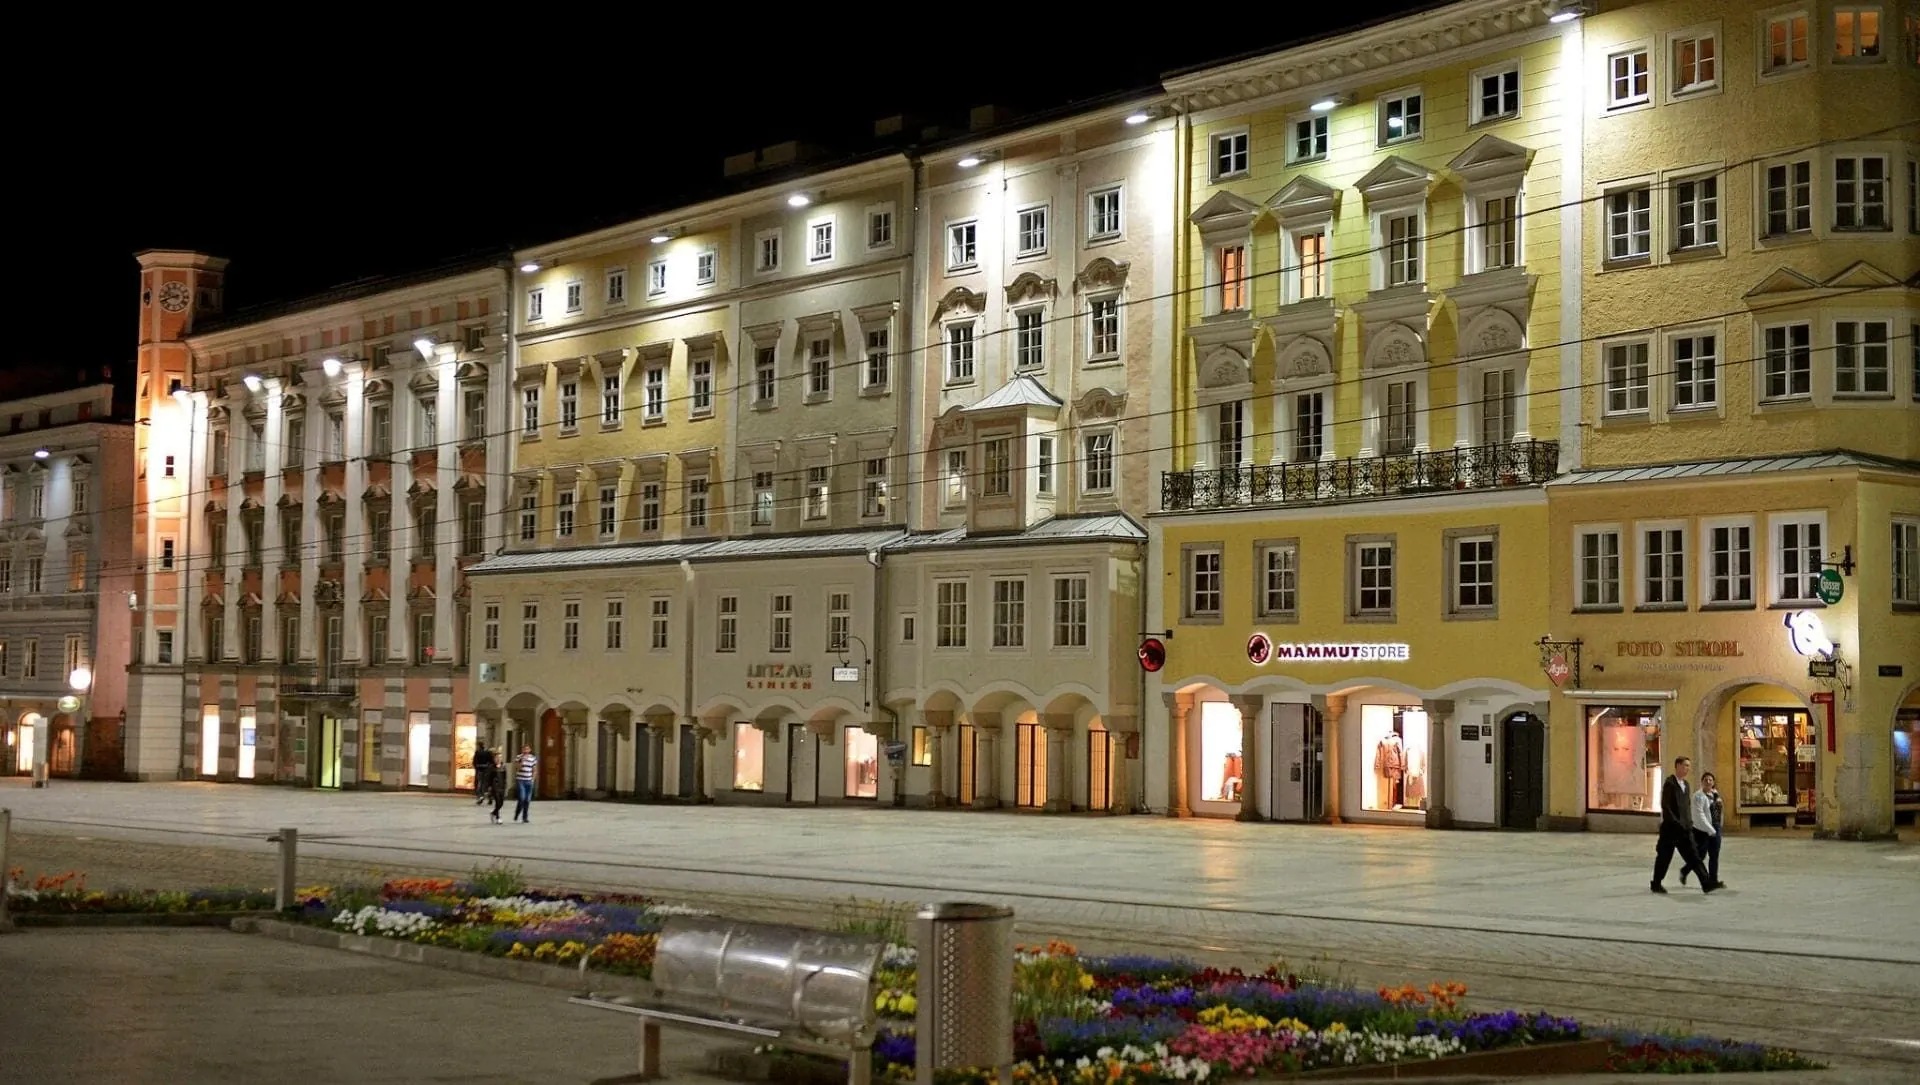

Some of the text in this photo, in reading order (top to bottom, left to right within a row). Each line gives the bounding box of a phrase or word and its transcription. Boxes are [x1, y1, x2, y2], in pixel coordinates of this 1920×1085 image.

[1277, 645, 1407, 659] MAMMUTSTORE
[1617, 640, 1744, 657] FOTO STROBL
[786, 664, 812, 678] AG
[746, 680, 812, 690] LINIEN
